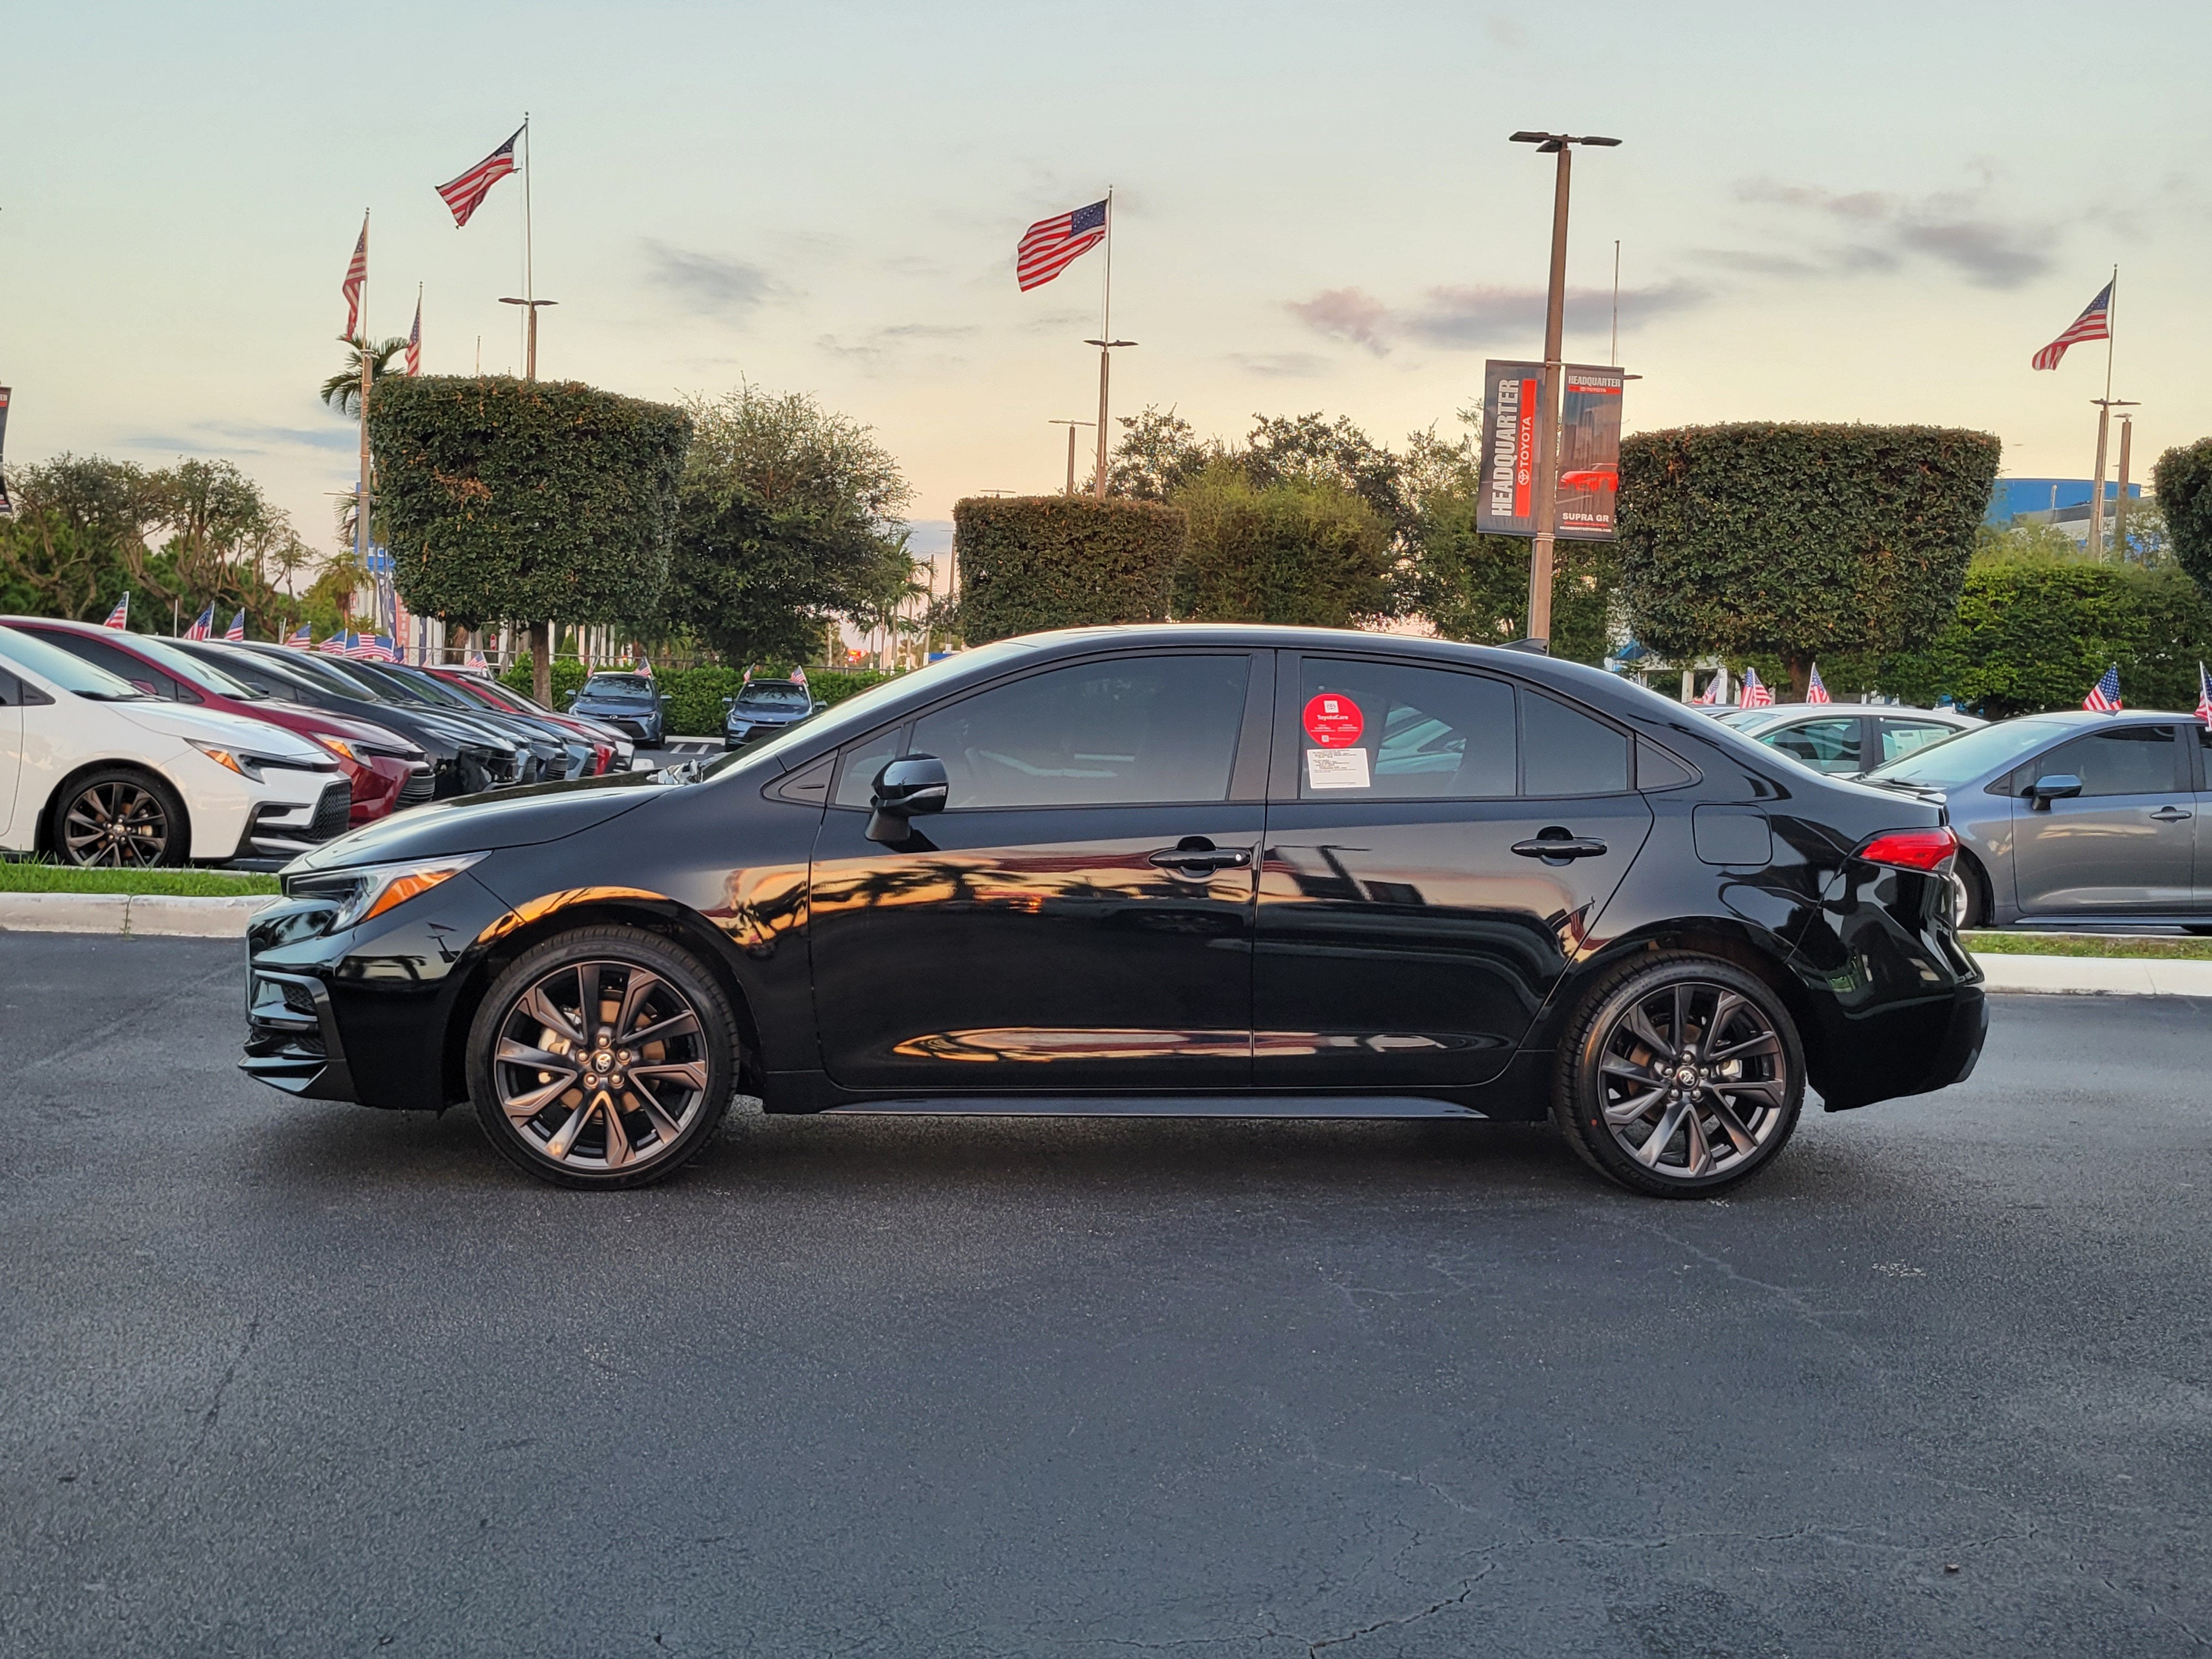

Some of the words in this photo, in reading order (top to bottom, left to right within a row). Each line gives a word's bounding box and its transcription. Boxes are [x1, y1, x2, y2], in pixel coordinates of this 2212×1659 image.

[1568, 375, 1621, 387] HEADQUARTER
[1492, 379, 1520, 517] HEADQUARTER
[1520, 416, 1532, 468] TOYOTA
[1562, 512, 1593, 522] SUPRA
